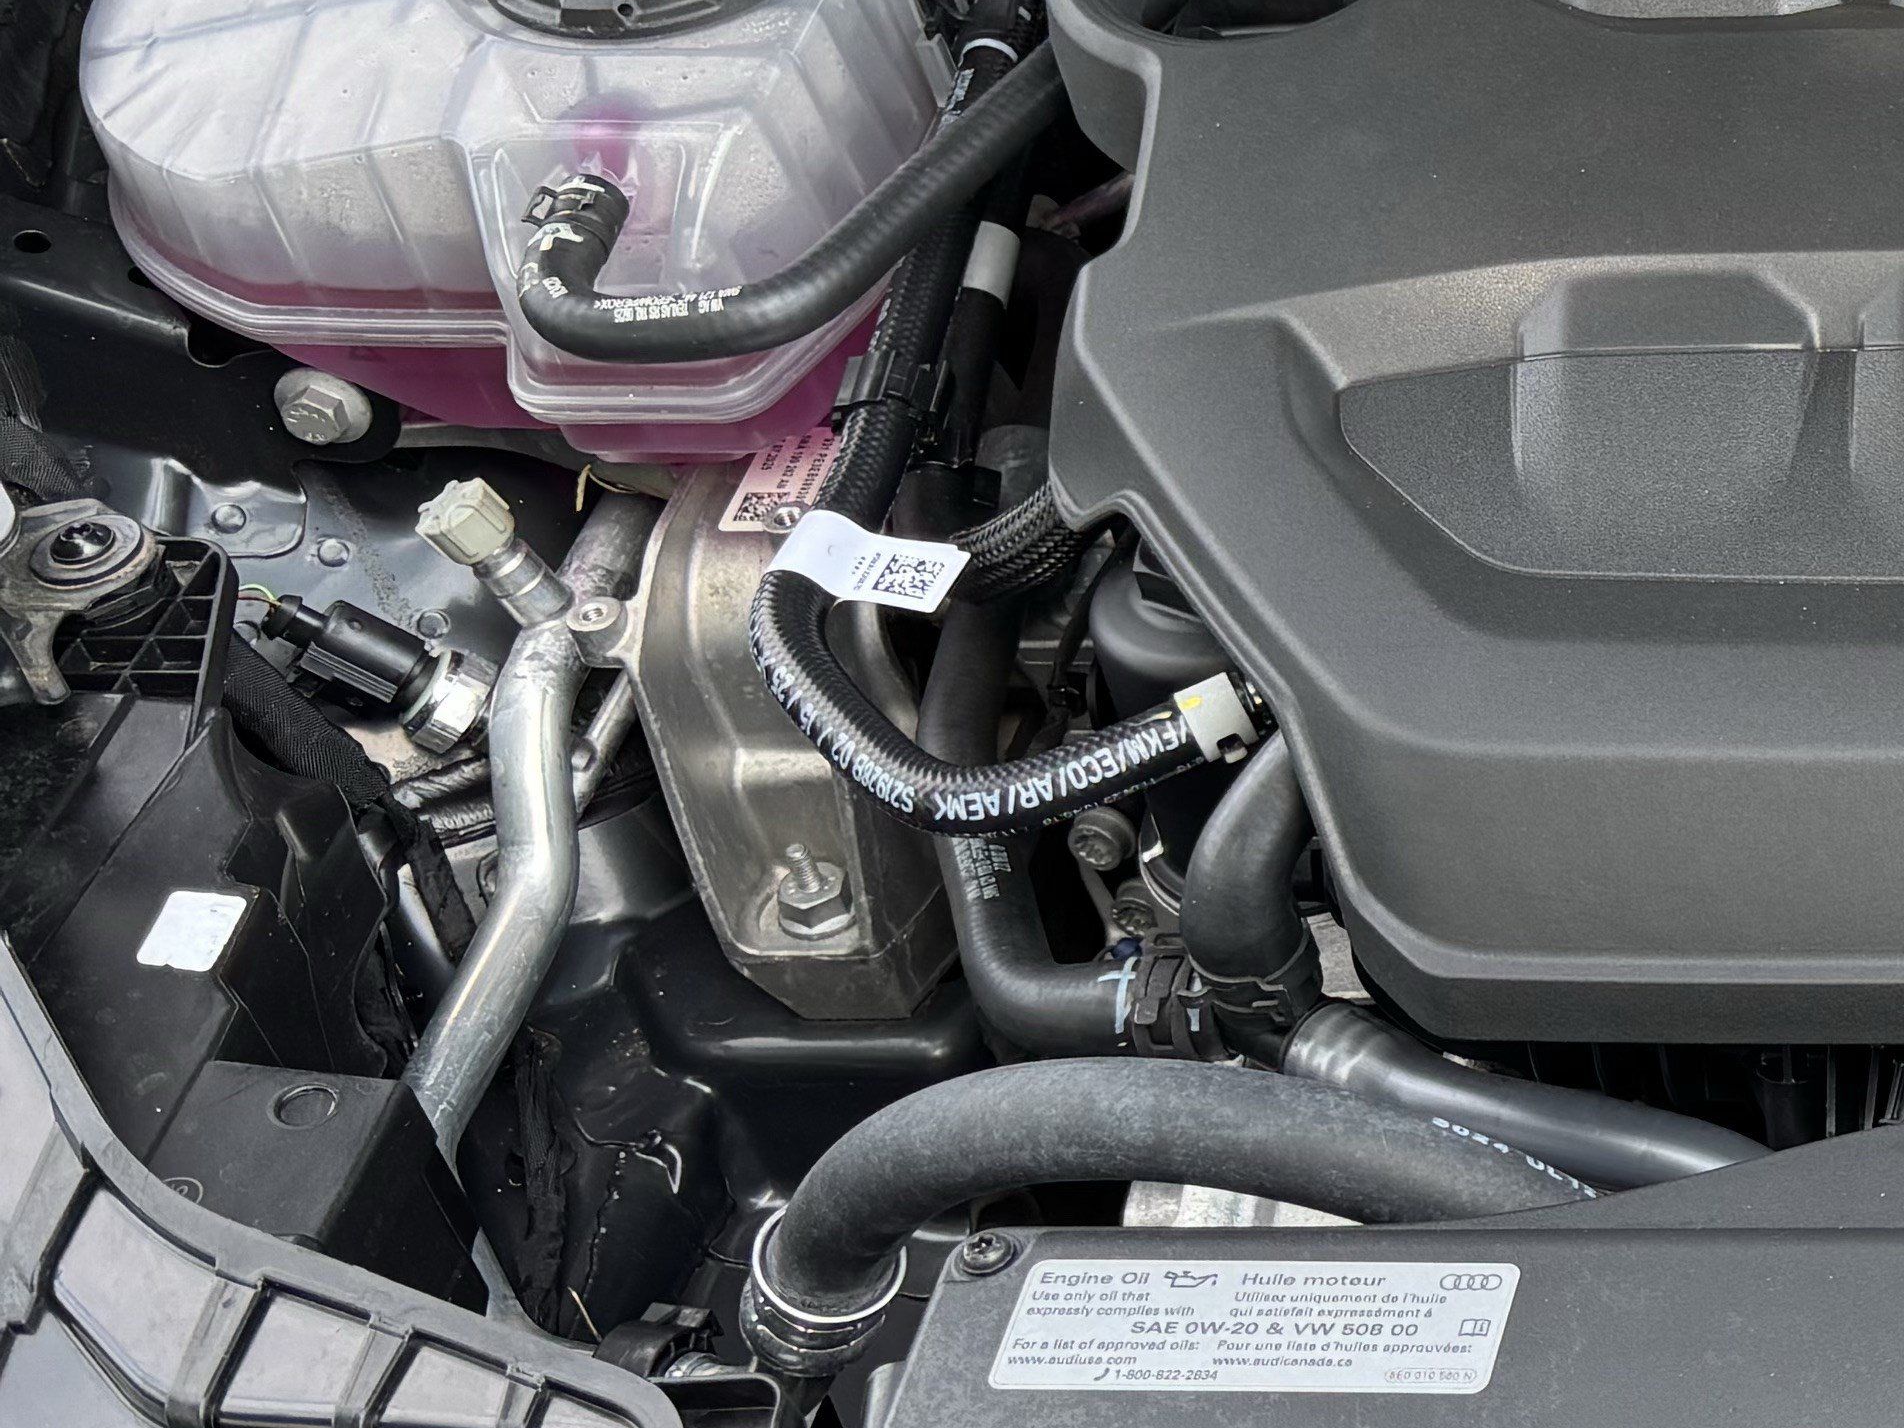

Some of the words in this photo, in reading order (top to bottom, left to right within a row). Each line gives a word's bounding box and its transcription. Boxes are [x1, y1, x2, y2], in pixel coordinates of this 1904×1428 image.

[1039, 1271, 1113, 1286] Engine
[1120, 1271, 1150, 1284] Oil
[1241, 1272, 1296, 1286] Huile
[1302, 1275, 1386, 1286] moteur
[1031, 1290, 1059, 1301] Use
[1062, 1289, 1095, 1302] only
[1098, 1290, 1118, 1301] oil
[1121, 1290, 1150, 1301] that
[1234, 1291, 1286, 1302] Utiliser
[1289, 1292, 1377, 1304] uniquement
[1380, 1293, 1398, 1303] de
[1025, 1304, 1093, 1317] expressly
[1096, 1304, 1160, 1317] complies
[1164, 1305, 1194, 1316] with
[1229, 1306, 1253, 1317] qui
[1255, 1306, 1313, 1317] satisfait
[1130, 1320, 1179, 1334] SAE
[1184, 1321, 1259, 1334] 0W-20
[1265, 1321, 1284, 1335] &
[1294, 1322, 1335, 1335] VW
[1341, 1322, 1383, 1336] 508
[1390, 1323, 1418, 1336] 00
[1011, 1337, 1037, 1349] For
[1052, 1338, 1075, 1349] list
[1077, 1338, 1095, 1350] of
[1096, 1339, 1167, 1351] approved
[1169, 1339, 1200, 1350] oils:
[1216, 1339, 1251, 1350] Pour
[1254, 1342, 1282, 1351] une
[1286, 1340, 1316, 1351] liste
[1007, 1353, 1137, 1365] www.audiusa.com
[1212, 1355, 1352, 1367] www.audicanada.ca
[1114, 1368, 1218, 1380] 1-800-822-2834
